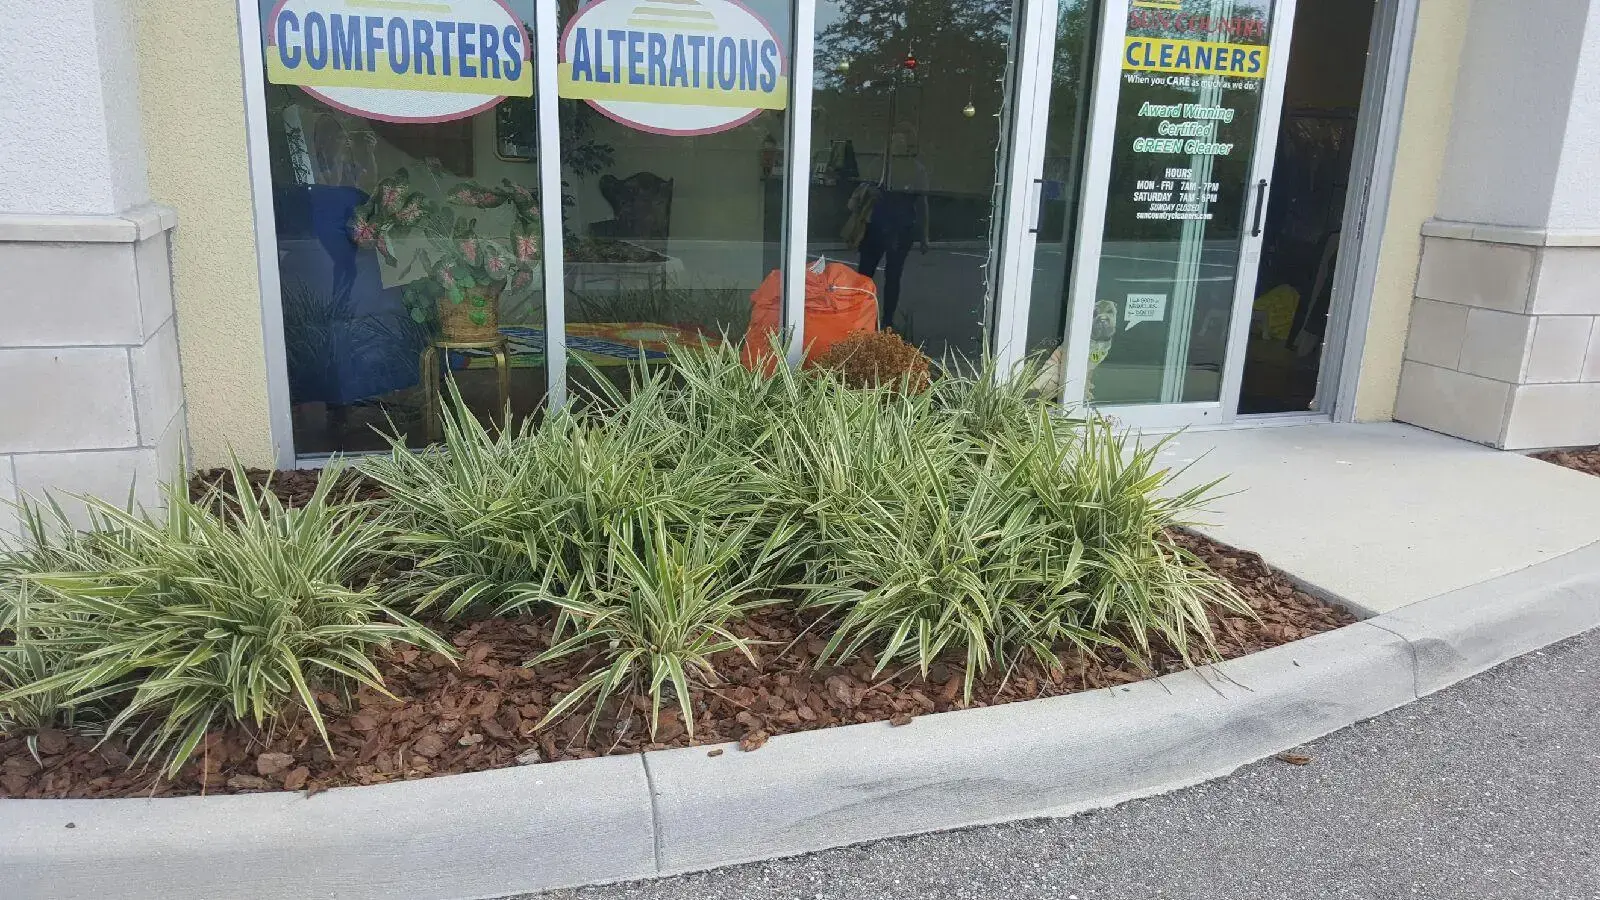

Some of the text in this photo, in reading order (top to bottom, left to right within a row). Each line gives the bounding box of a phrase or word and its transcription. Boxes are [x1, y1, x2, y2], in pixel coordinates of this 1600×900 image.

[1129, 10, 1265, 37] SUN COUNTRY
[277, 9, 522, 82] COMFORTERS
[572, 27, 777, 94] ALTERATIONS
[1125, 41, 1262, 74] CLEANERS
[1151, 78, 1166, 86] you
[1166, 76, 1191, 87] CARE
[1201, 79, 1222, 88] much
[1138, 101, 1234, 123] Award Winning
[1158, 120, 1213, 136] Certified
[1132, 137, 1233, 155] GREEN Cleaner
[1165, 168, 1193, 178] HOURS
[1136, 180, 1155, 190] MON
[1161, 181, 1174, 190] FRI
[1180, 182, 1197, 191] 7AM
[1203, 182, 1219, 191] 7PM
[1133, 192, 1173, 201] SATURDAY
[1179, 193, 1195, 202] 7AM
[1149, 203, 1200, 211] SUNDAY CLOSED
[1136, 212, 1213, 220] suncountrycleaners.com
